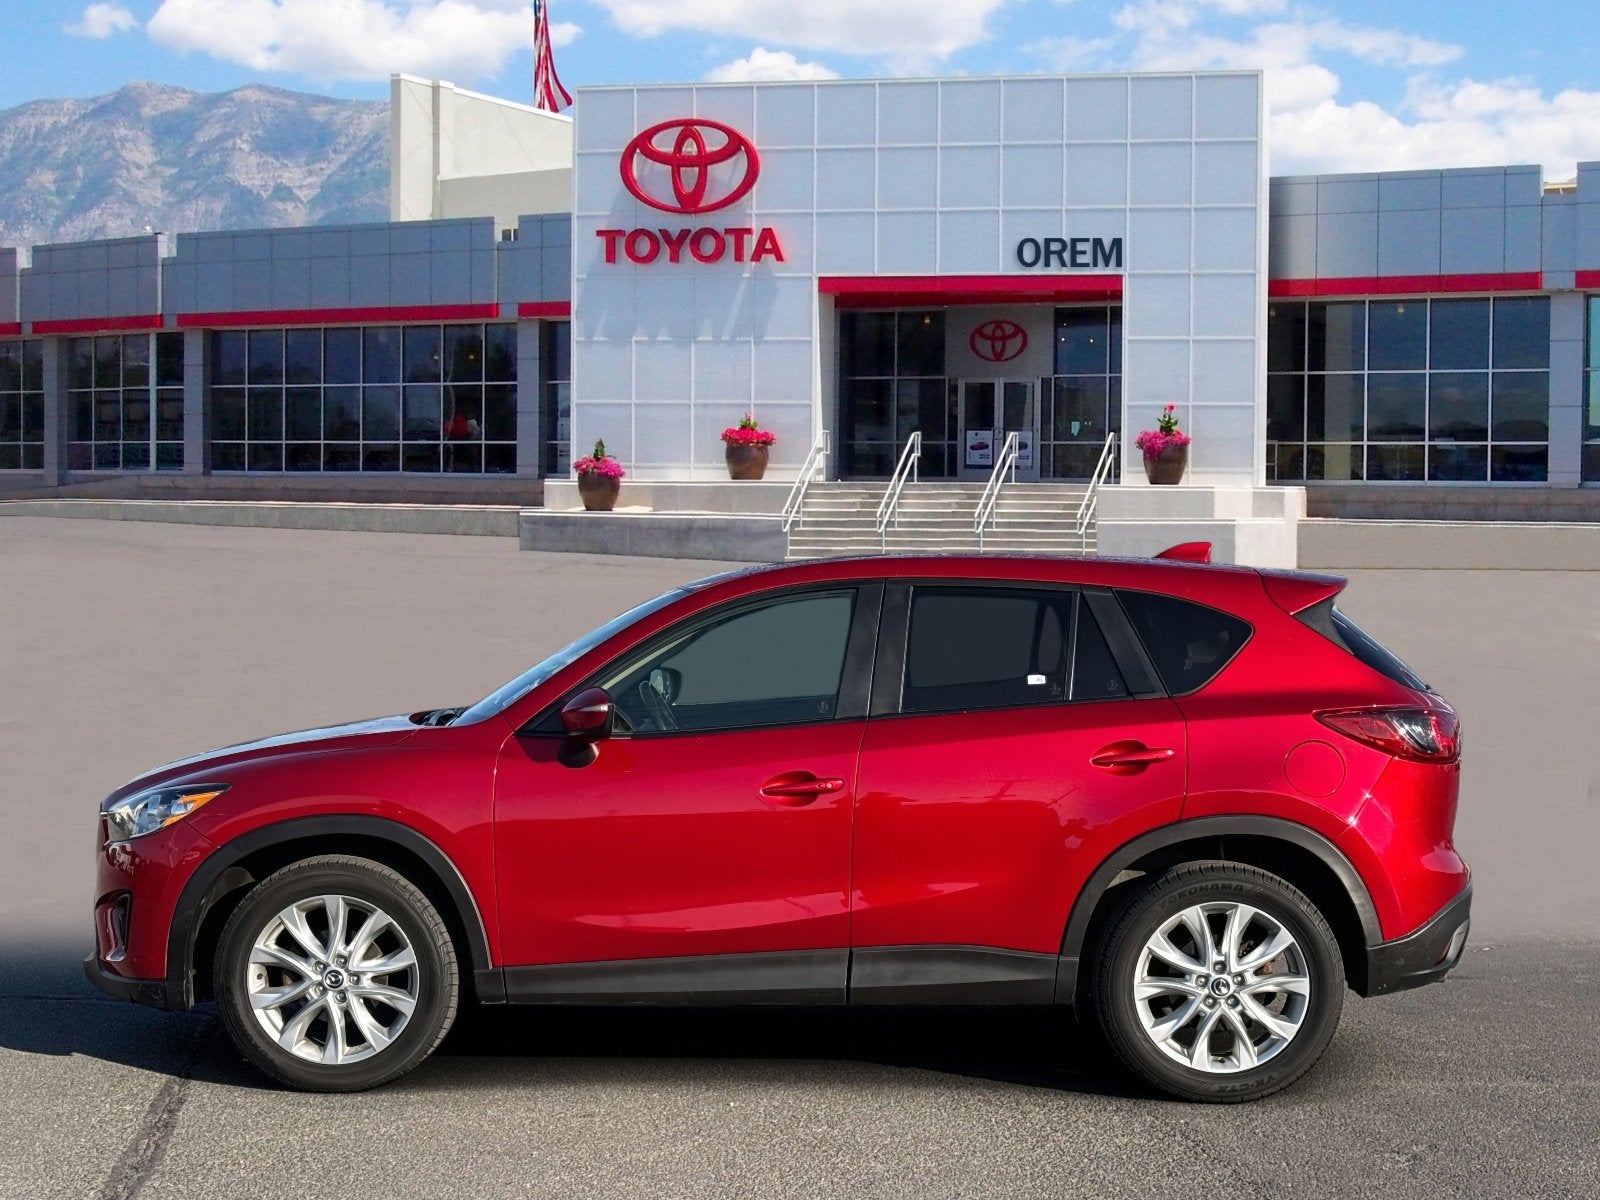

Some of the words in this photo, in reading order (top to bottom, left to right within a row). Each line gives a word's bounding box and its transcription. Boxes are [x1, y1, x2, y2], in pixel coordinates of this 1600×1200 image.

[596, 227, 784, 264] TOYOTA
[1017, 237, 1123, 268] OREM
[1159, 883, 1244, 909] YOKOHAMA
